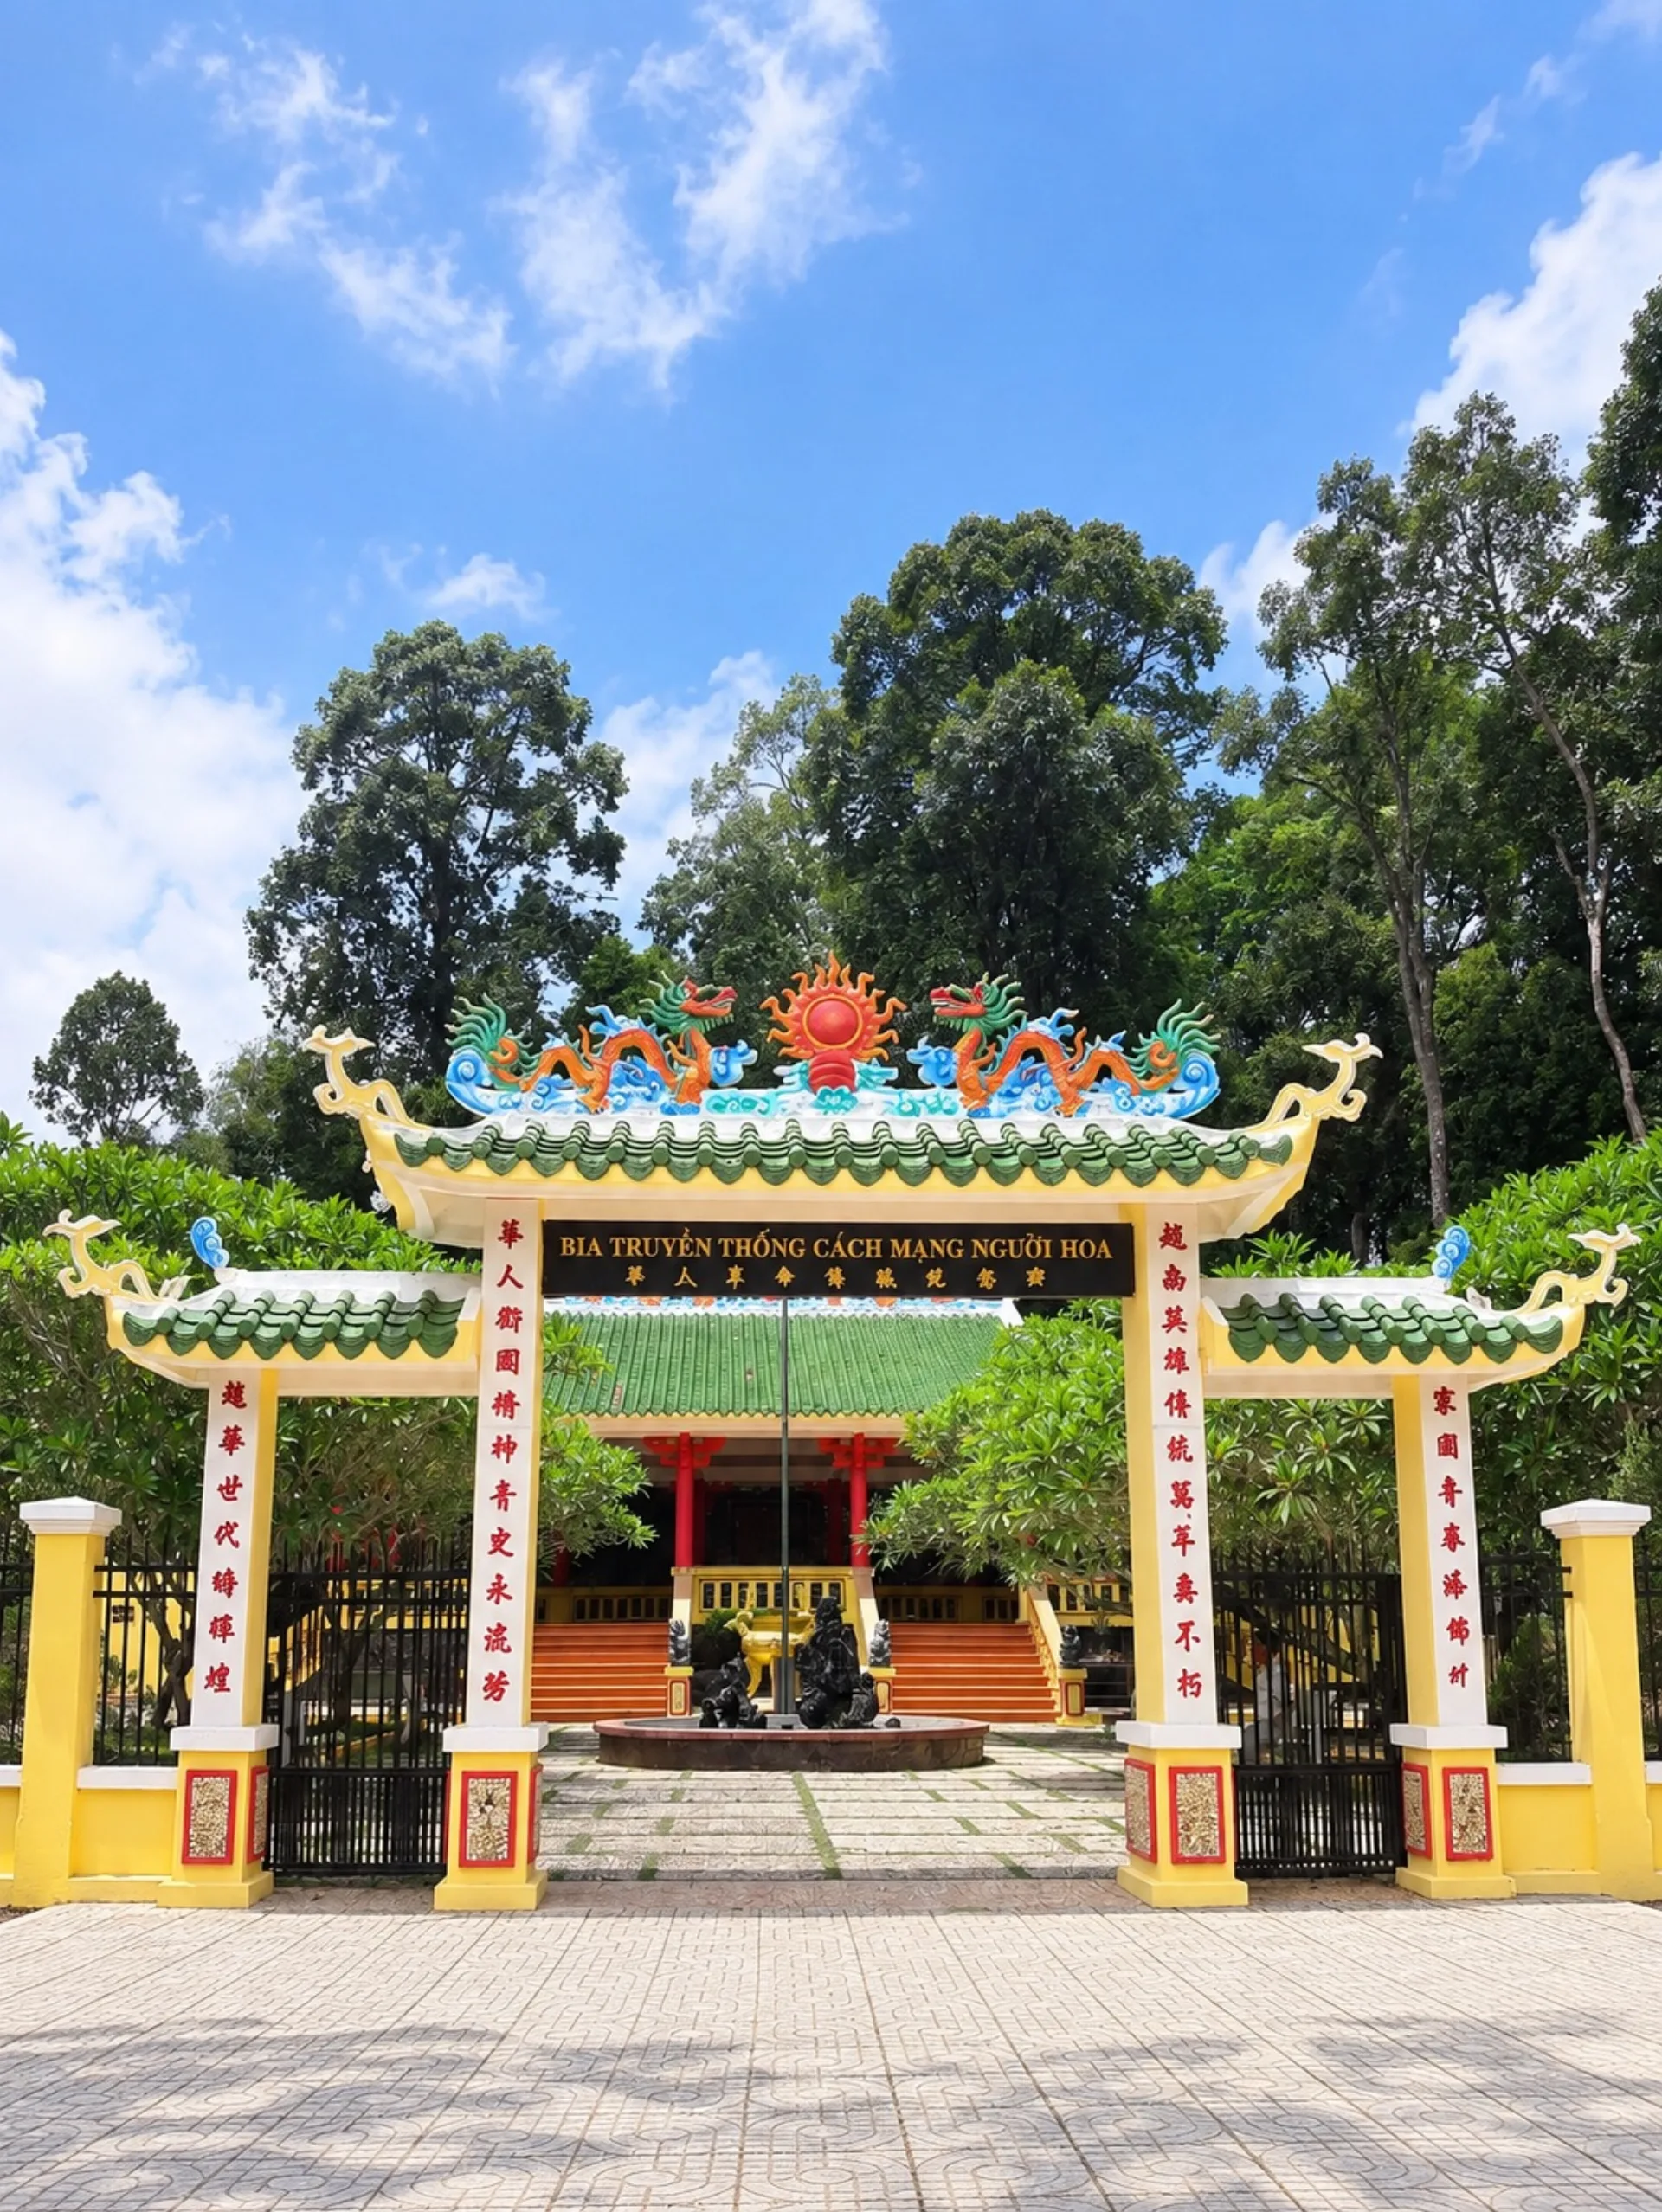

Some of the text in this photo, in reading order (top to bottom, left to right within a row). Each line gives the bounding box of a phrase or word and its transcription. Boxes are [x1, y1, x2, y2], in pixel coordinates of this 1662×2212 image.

[561, 1237, 603, 1257] BIA
[609, 1227, 712, 1257] TRUYỀN
[718, 1228, 806, 1258] THỐNG
[813, 1231, 883, 1258] CÁCH
[889, 1238, 964, 1264] MẠNG
[1060, 1238, 1113, 1259] HOA
